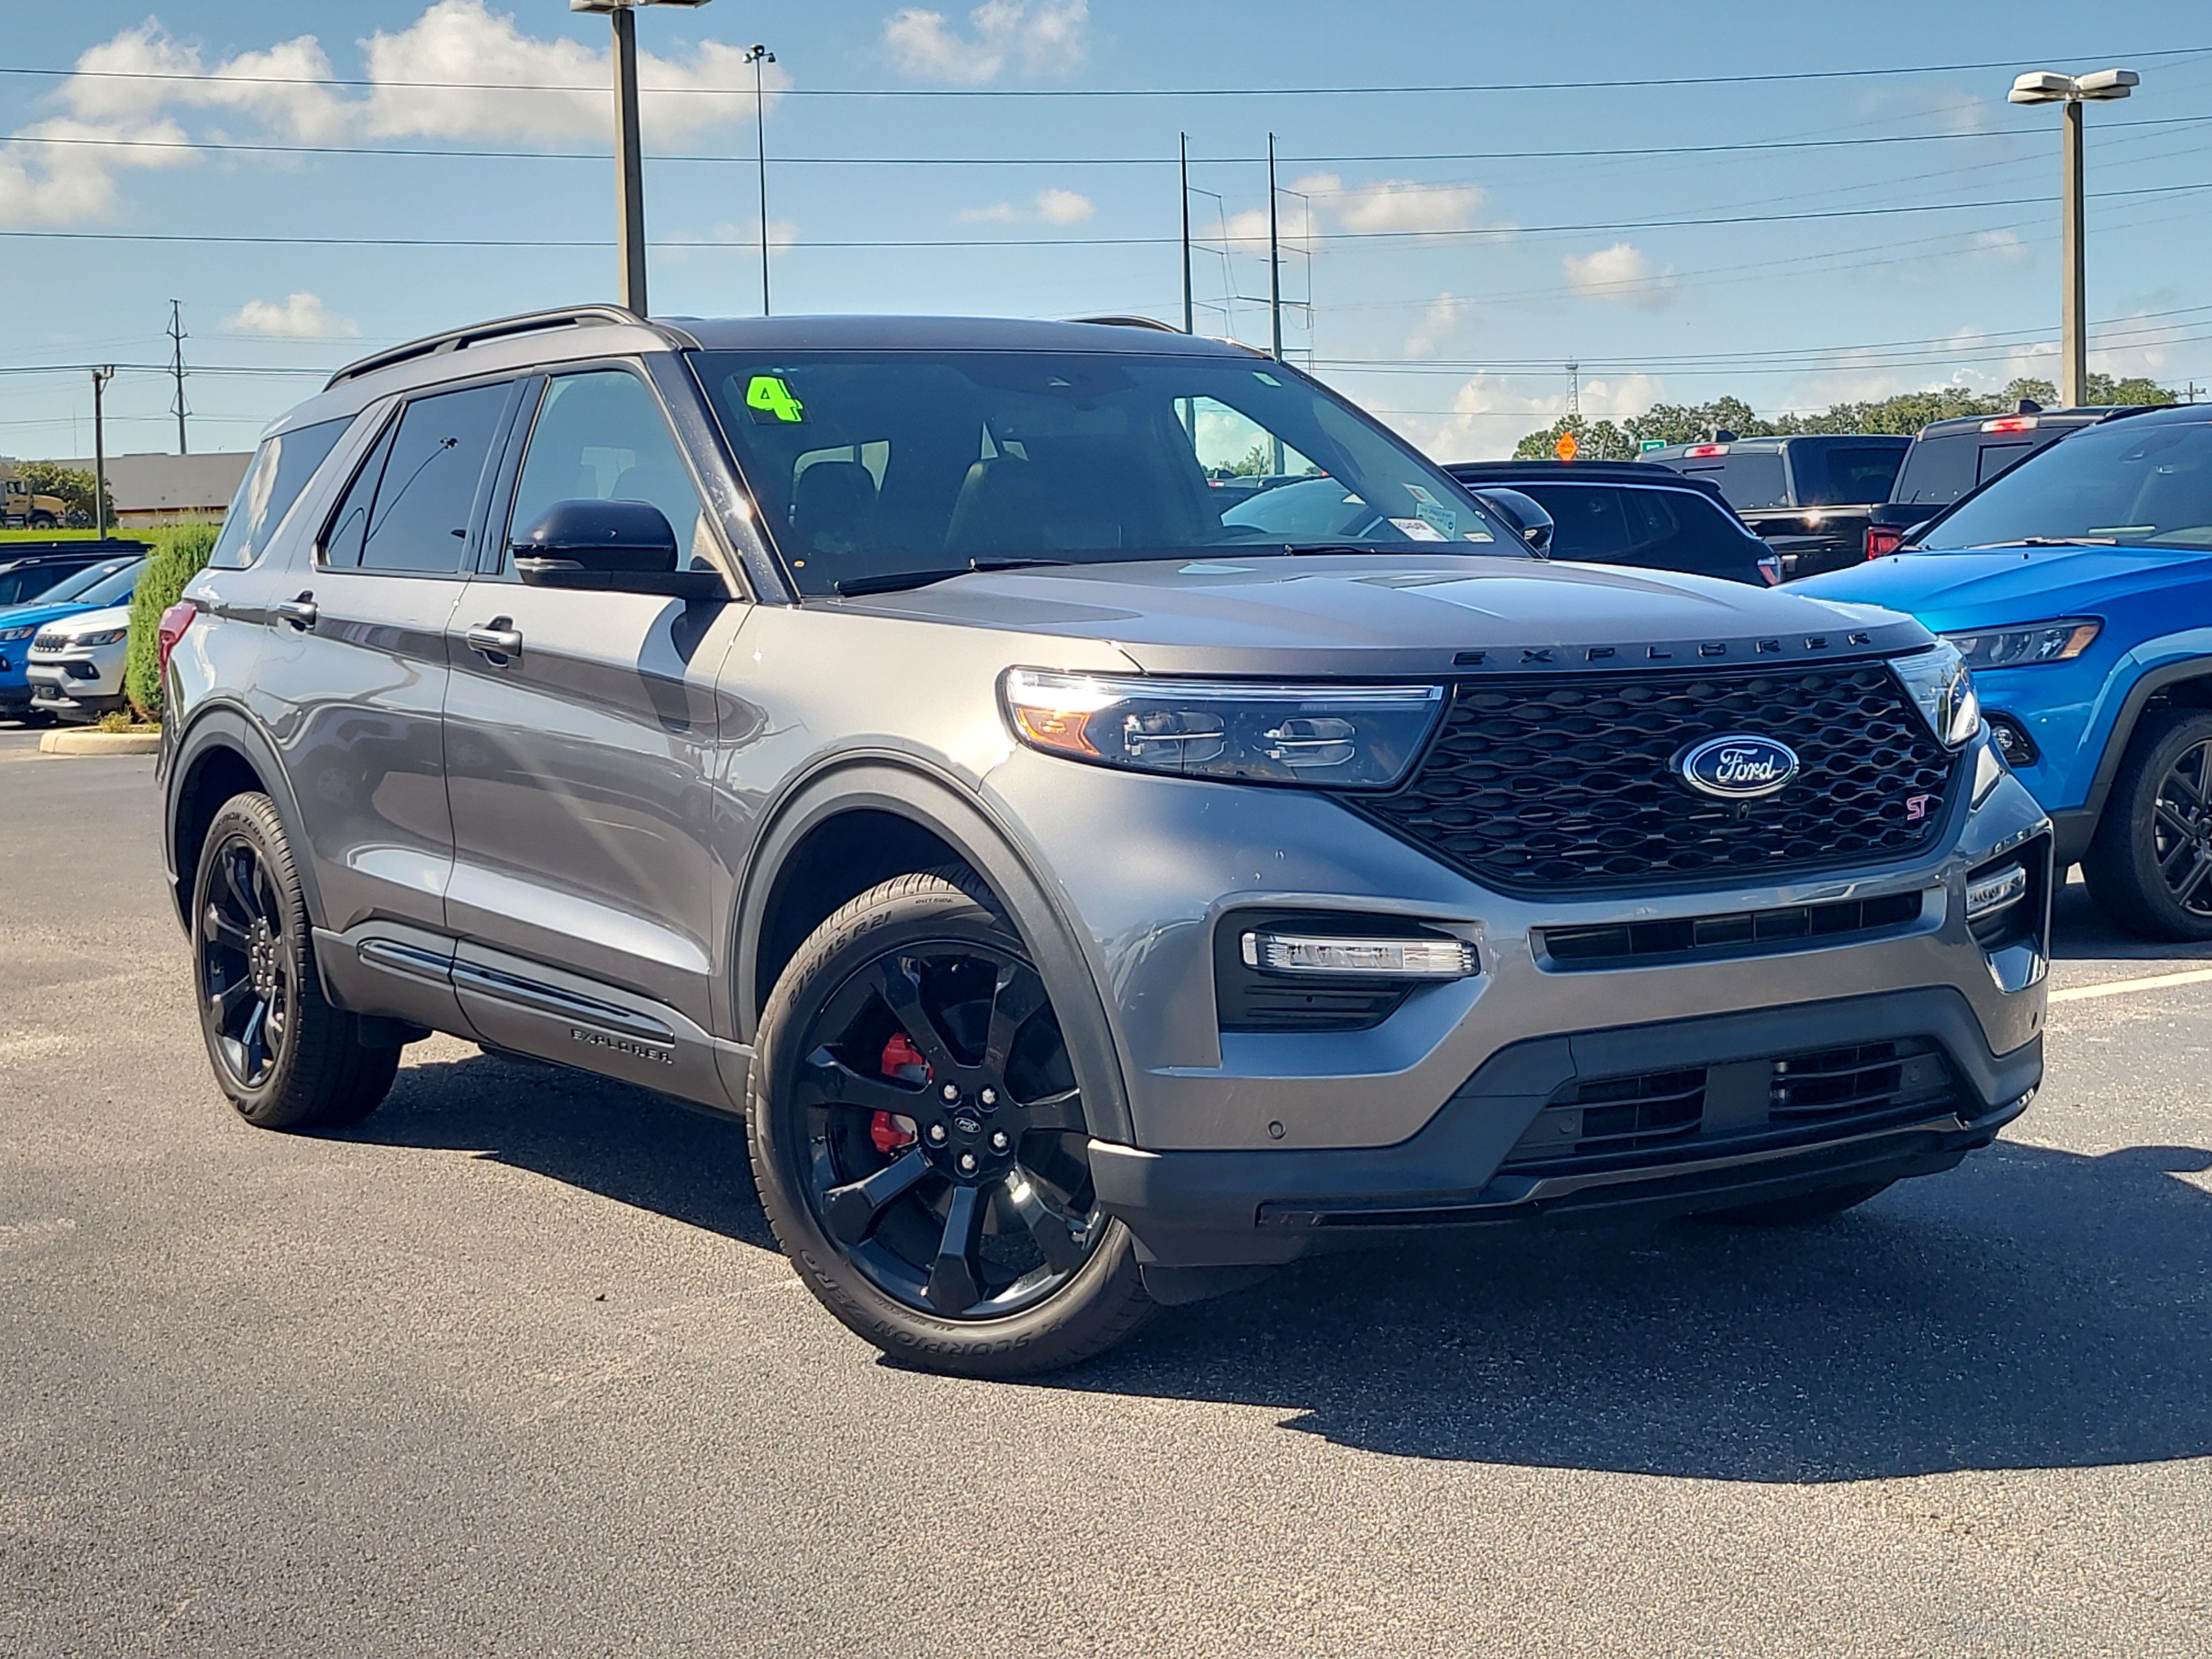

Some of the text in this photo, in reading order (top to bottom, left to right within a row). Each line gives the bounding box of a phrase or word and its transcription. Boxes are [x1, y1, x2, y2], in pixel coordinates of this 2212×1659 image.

[746, 375, 803, 422] 4
[1451, 632, 1871, 665] EXPLORER
[1716, 748, 1780, 782] Ford
[1906, 794, 1929, 820] ST
[787, 933, 848, 1010] 275/45
[800, 1249, 1032, 1357] SCORPION ZERO
